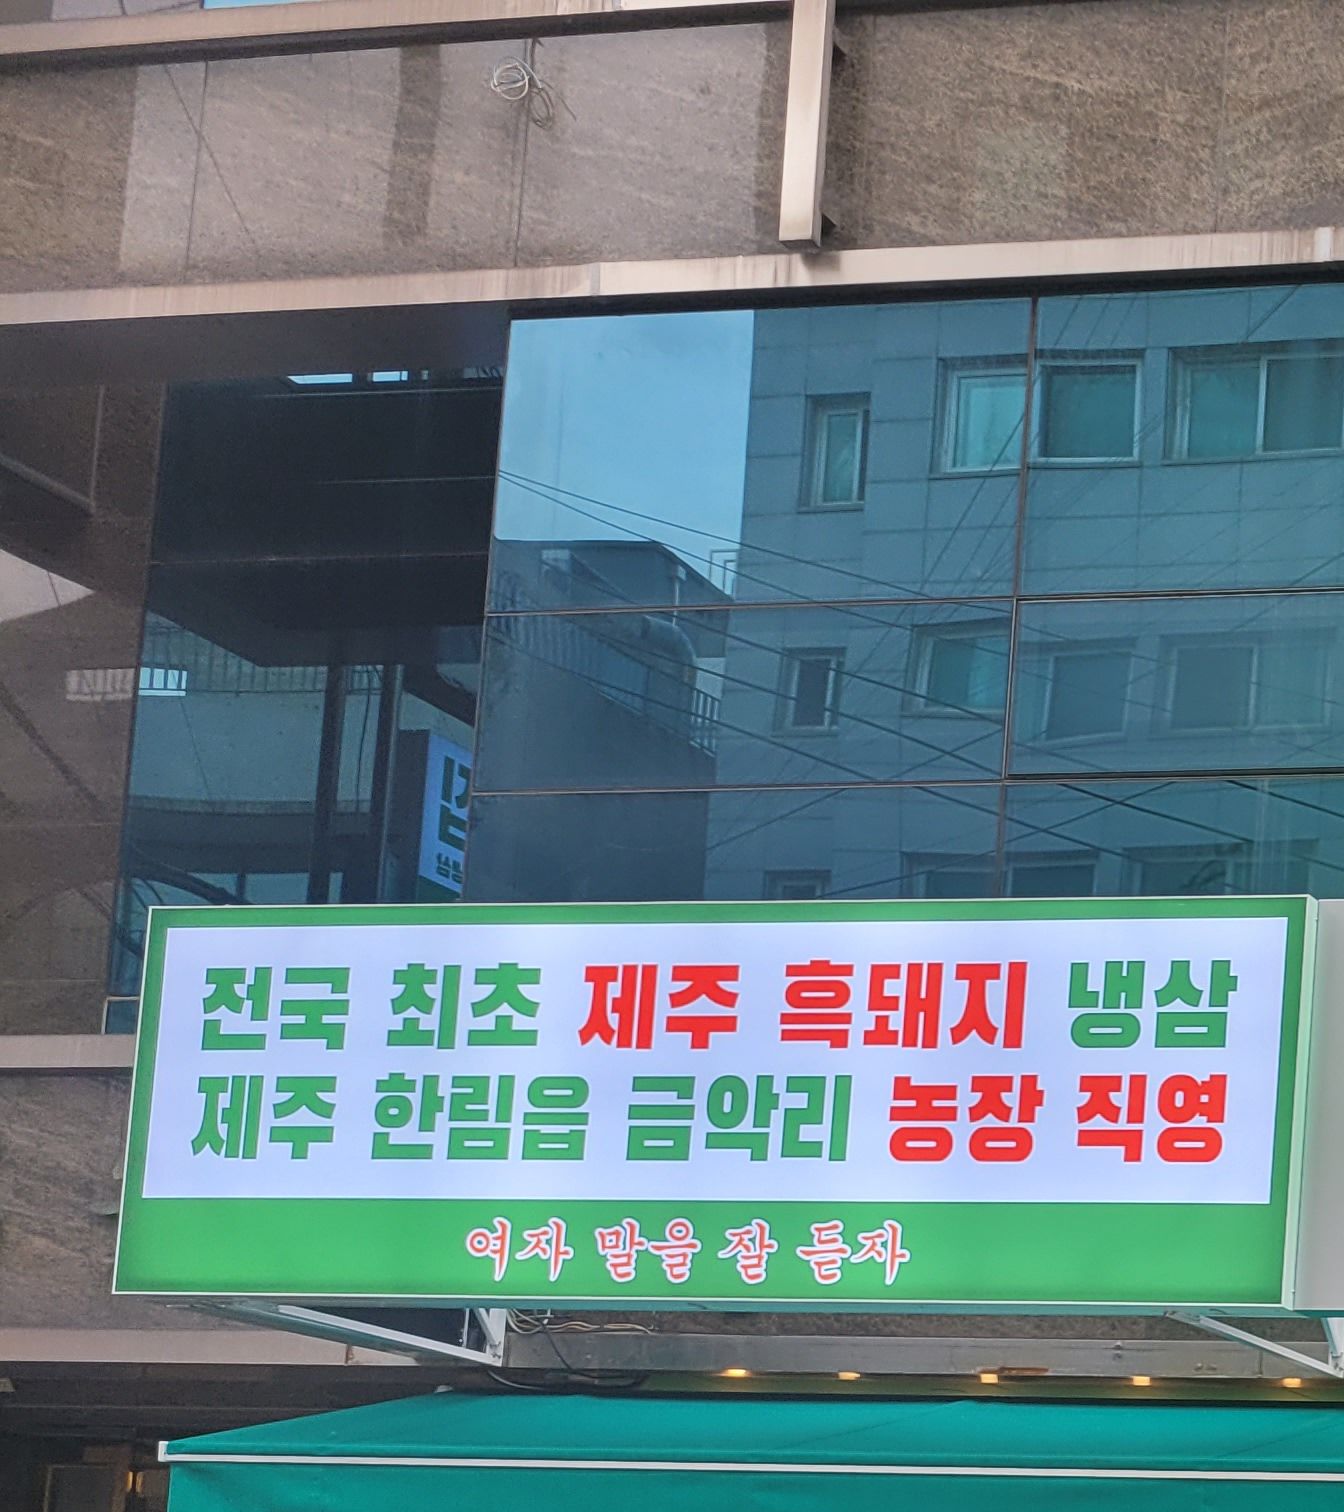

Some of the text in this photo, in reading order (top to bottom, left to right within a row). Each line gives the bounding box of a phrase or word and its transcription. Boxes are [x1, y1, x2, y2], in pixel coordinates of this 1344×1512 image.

[200, 959, 1238, 1053] 전국 최초 제주 흑돼지 냉삼
[191, 1072, 1228, 1165] 제주 한림읍 금악리 농장 직영
[464, 1217, 912, 1287] 여자 말을 잘 듣자
